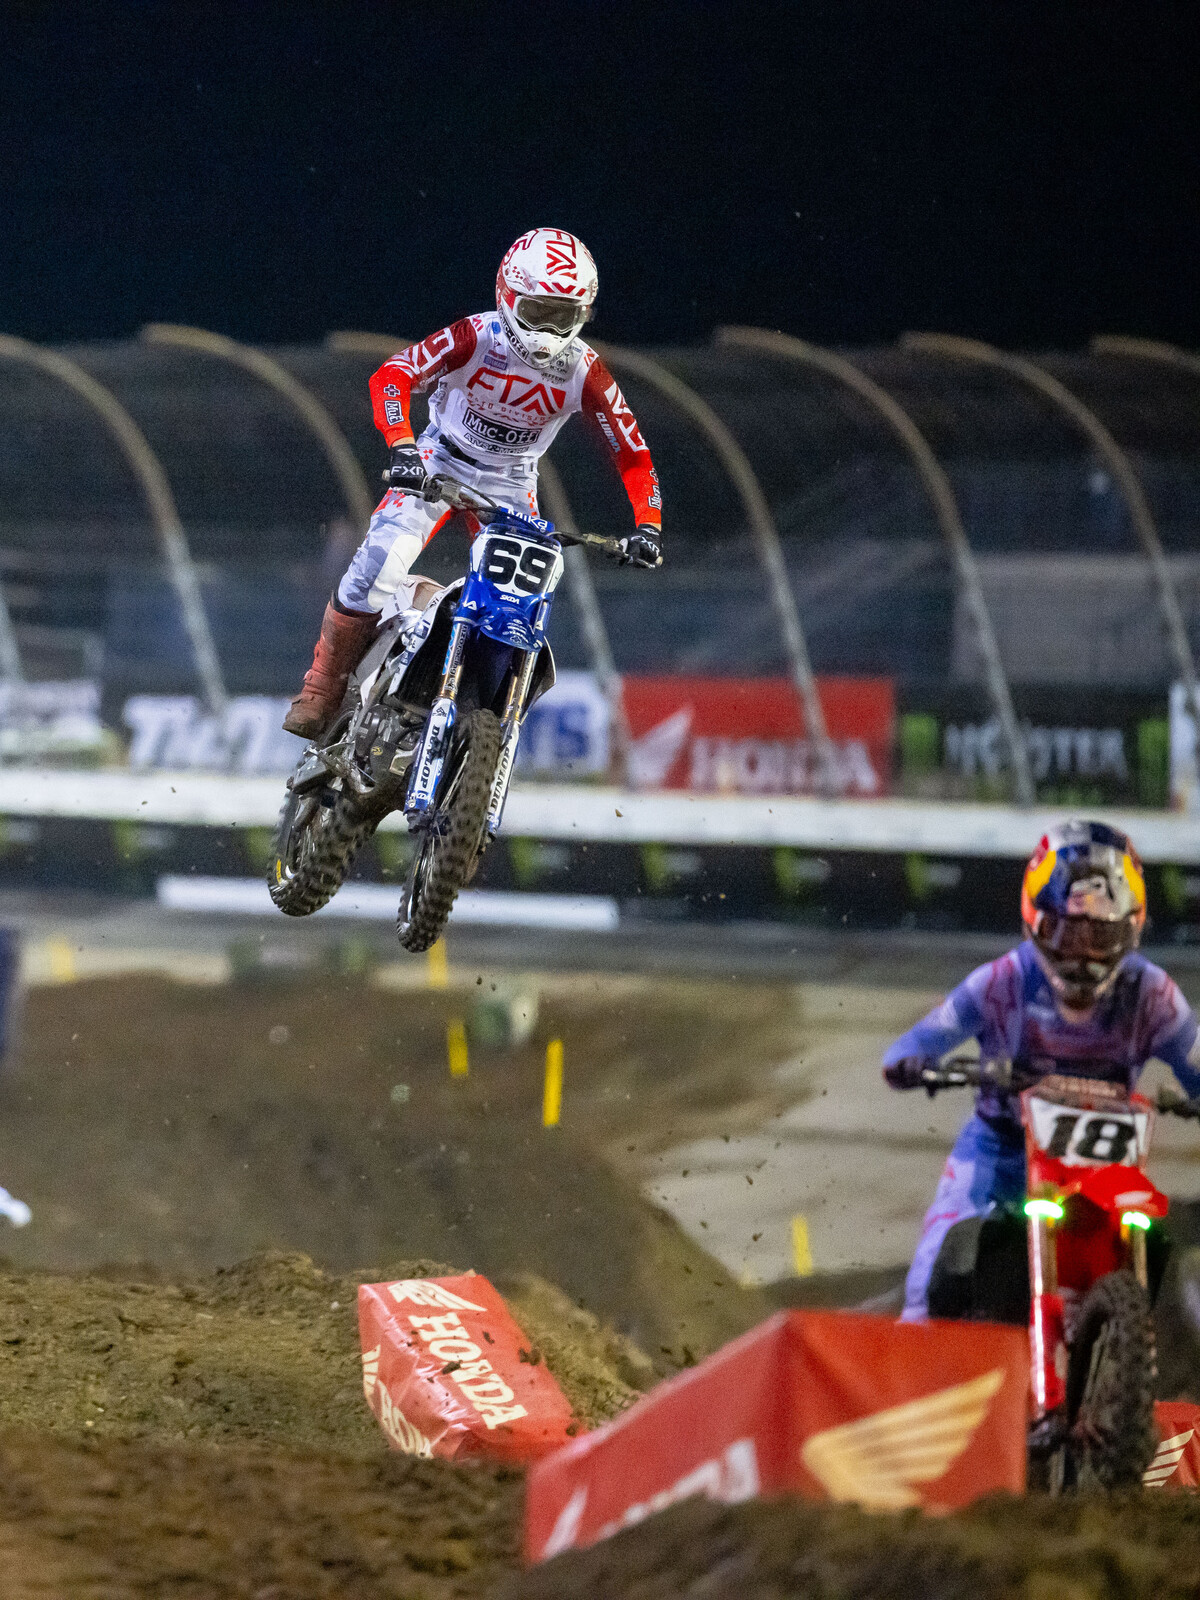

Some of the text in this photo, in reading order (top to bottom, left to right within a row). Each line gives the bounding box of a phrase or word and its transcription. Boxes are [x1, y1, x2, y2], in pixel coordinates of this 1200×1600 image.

[390, 465, 425, 476] FXR
[484, 537, 557, 595] 69
[490, 746, 511, 809] DUNLOP
[1046, 1113, 1137, 1163] 18
[408, 1312, 528, 1430] HONDA
